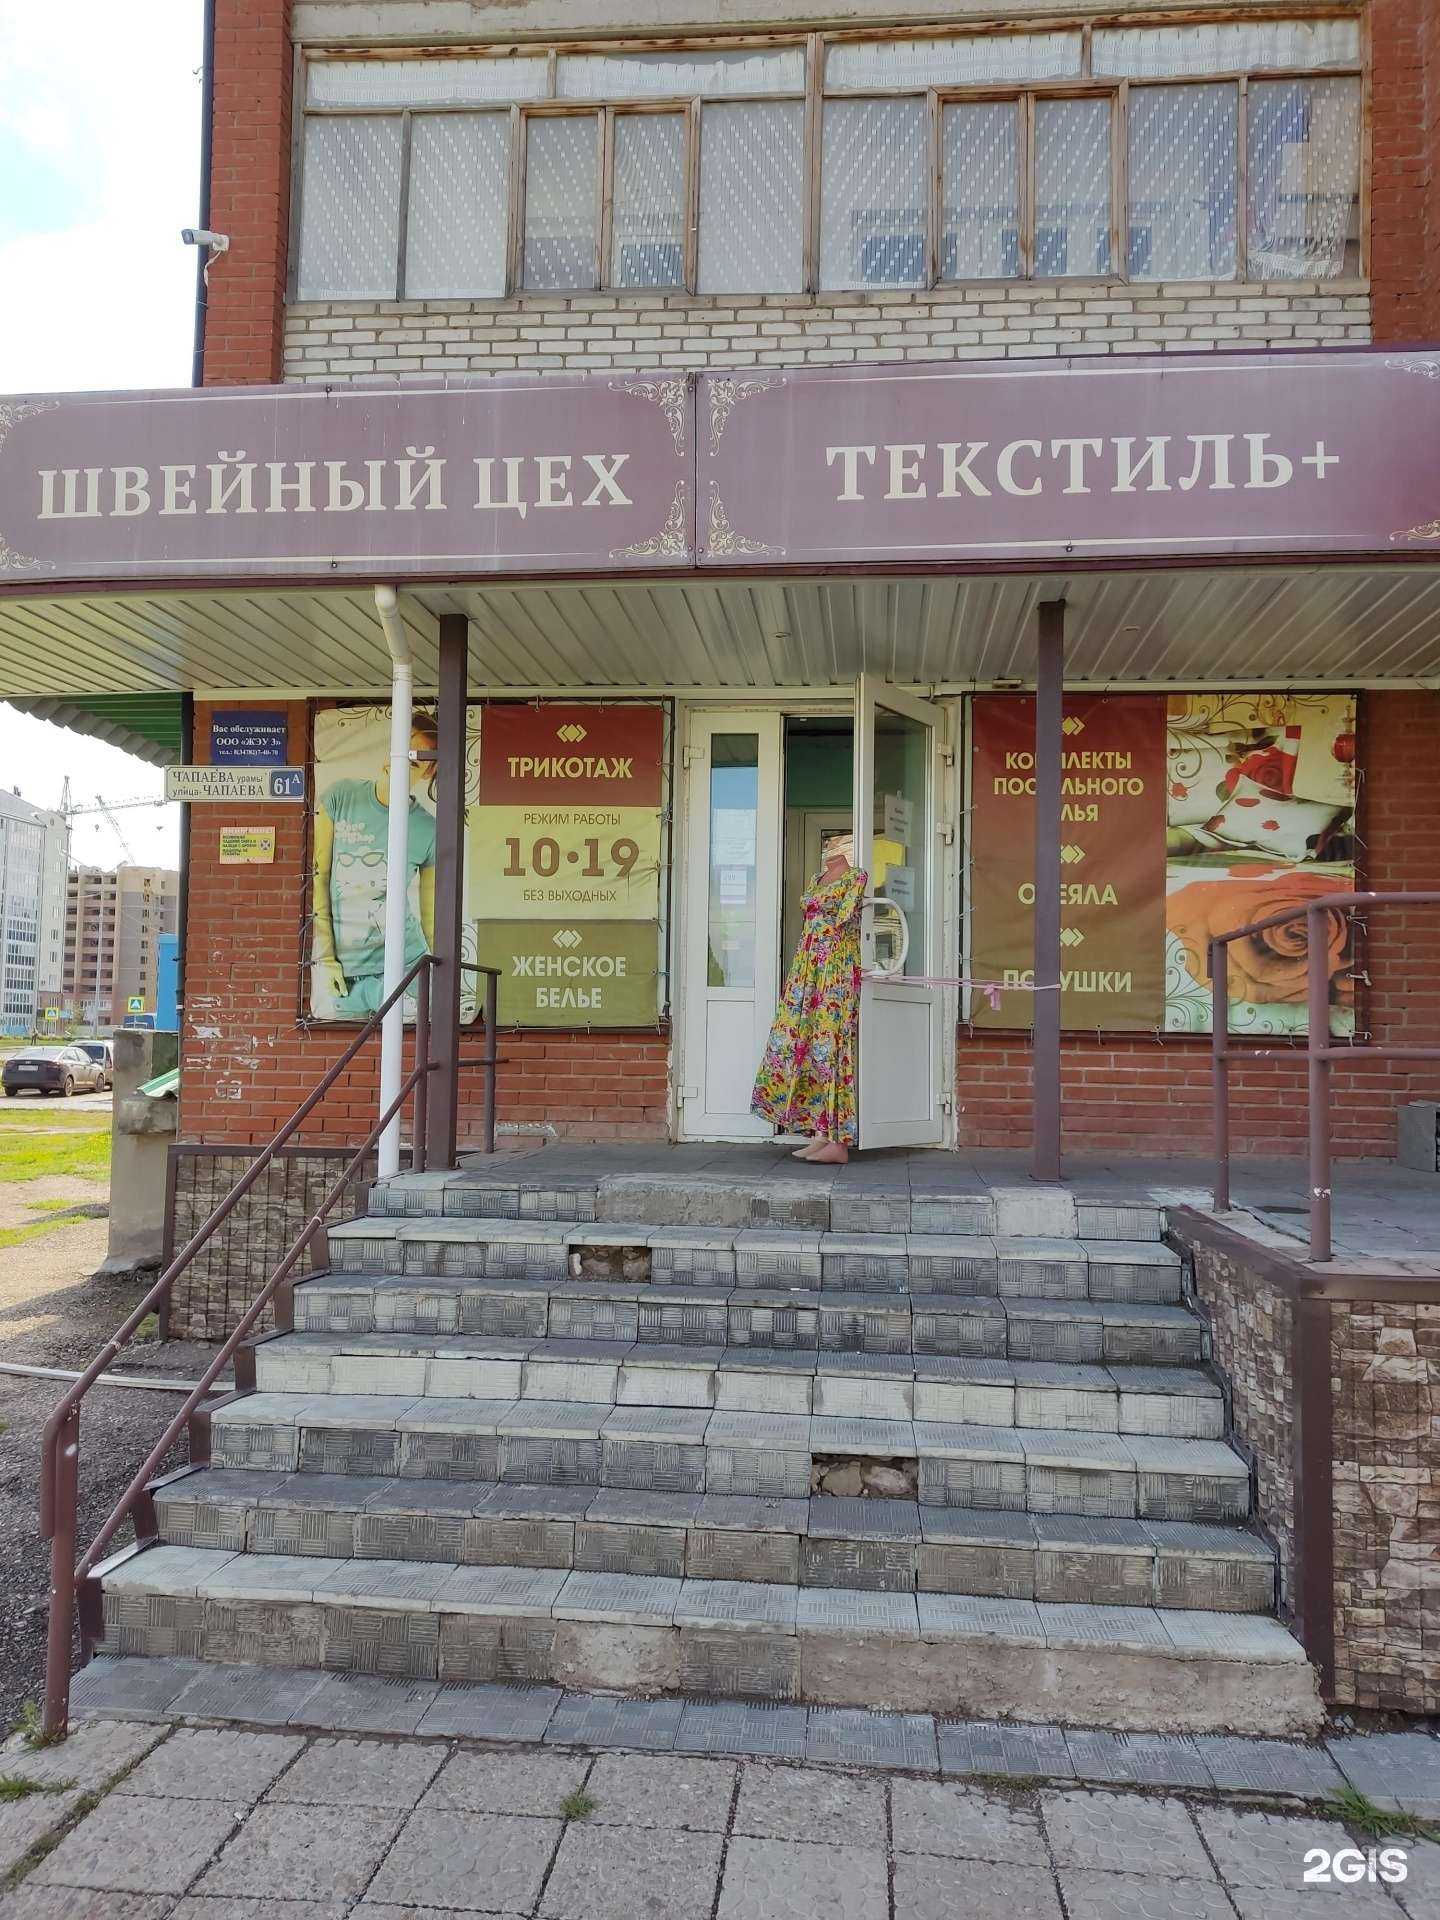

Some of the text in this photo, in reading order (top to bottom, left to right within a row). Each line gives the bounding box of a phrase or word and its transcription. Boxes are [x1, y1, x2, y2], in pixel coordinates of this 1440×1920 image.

[825, 432, 1340, 501] ТЕКСТИЛЬ+
[37, 445, 634, 519] ШВЕЙНЫЙ ЦЕХ
[212, 724, 286, 735] Вас обслуживает
[216, 737, 239, 746] ООО
[507, 756, 633, 779] ТРИКОТАЖ
[1005, 751, 1132, 770] КОЛЕКТЫ
[172, 771, 234, 783] ЧАПАЕВА
[993, 777, 1145, 796] ПОСЛЬНОГО
[172, 784, 265, 798] улица ЧАПАЕВА
[524, 812, 621, 826] РЕЖИМ РАБОТЫ
[1061, 803, 1099, 822] ЛЬЯ
[523, 889, 617, 903] БЕЗ ВЫХОДНЫХ
[1018, 883, 1119, 906] ОЕЯЛА
[511, 956, 627, 978] ЖЕНСКОЕ
[1003, 969, 1133, 993] ПОУШКИ
[536, 987, 603, 1009] БЕЛЬЕ
